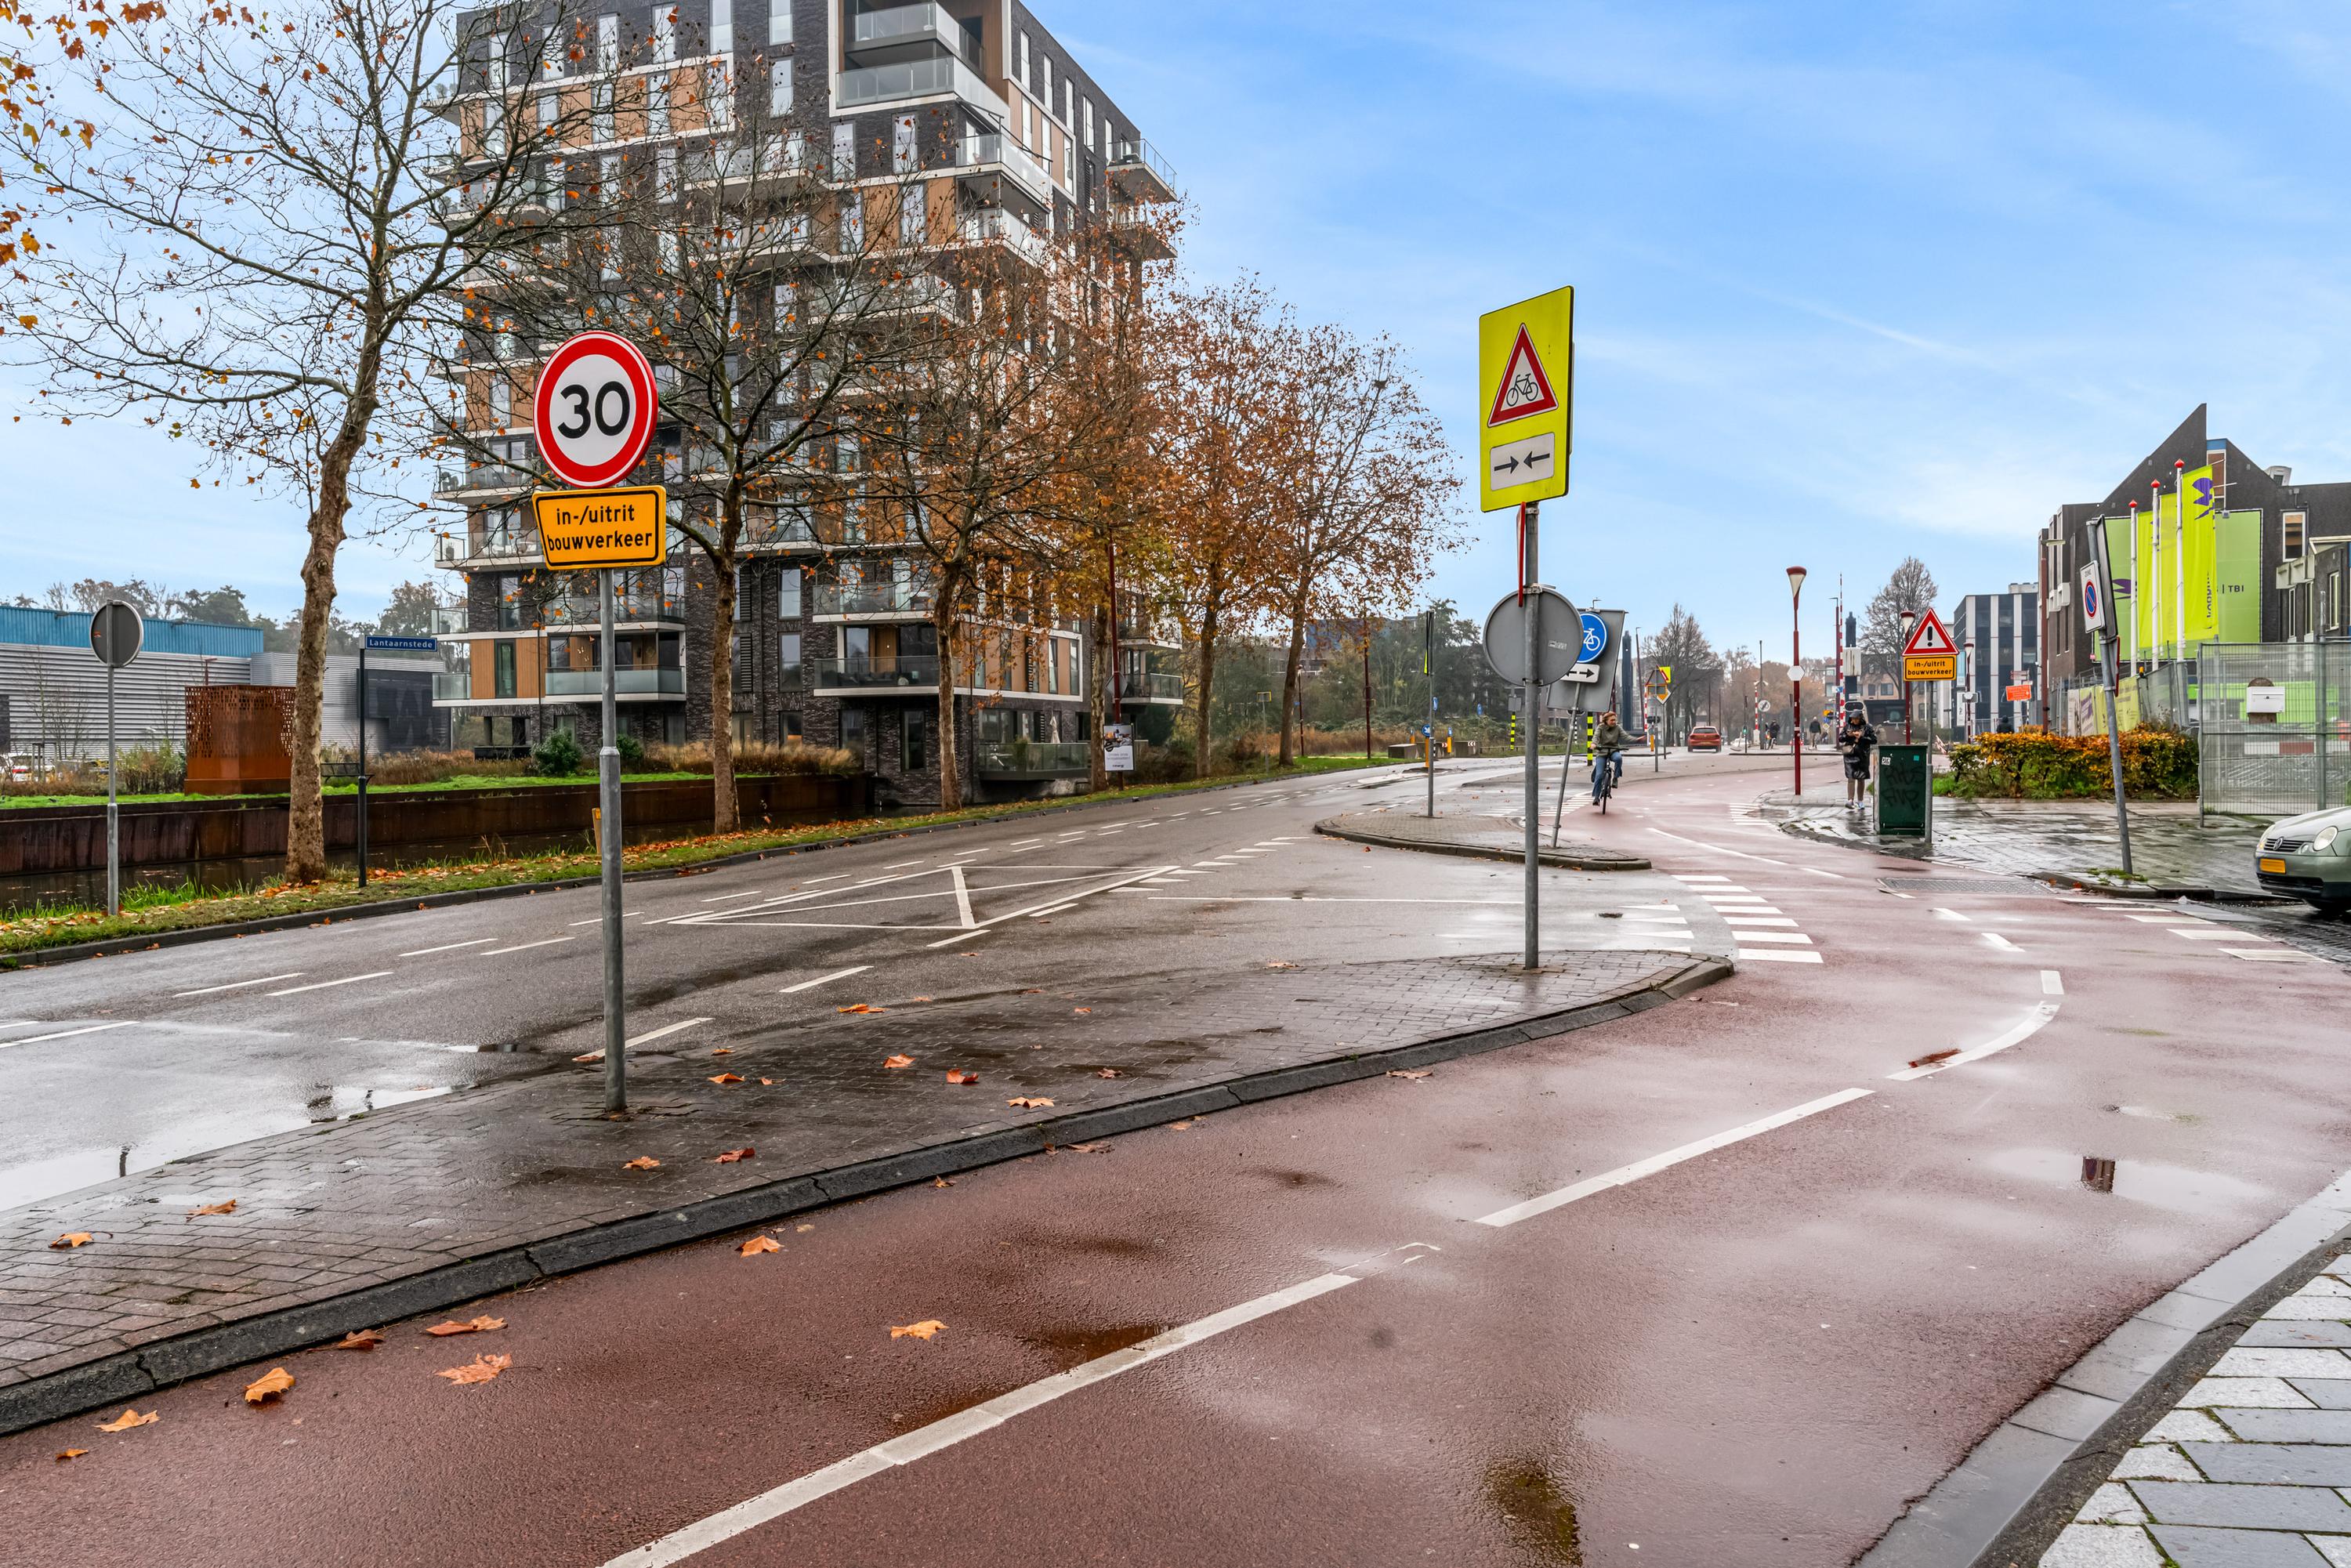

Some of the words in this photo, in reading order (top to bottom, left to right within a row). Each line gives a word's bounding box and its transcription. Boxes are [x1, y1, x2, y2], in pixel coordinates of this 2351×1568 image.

[557, 381, 630, 439] 30
[556, 504, 635, 526] in-/uitrit
[547, 531, 652, 551] bouwverkeer
[2227, 585, 2244, 593] TBI
[369, 639, 433, 649] Lantaarnstede
